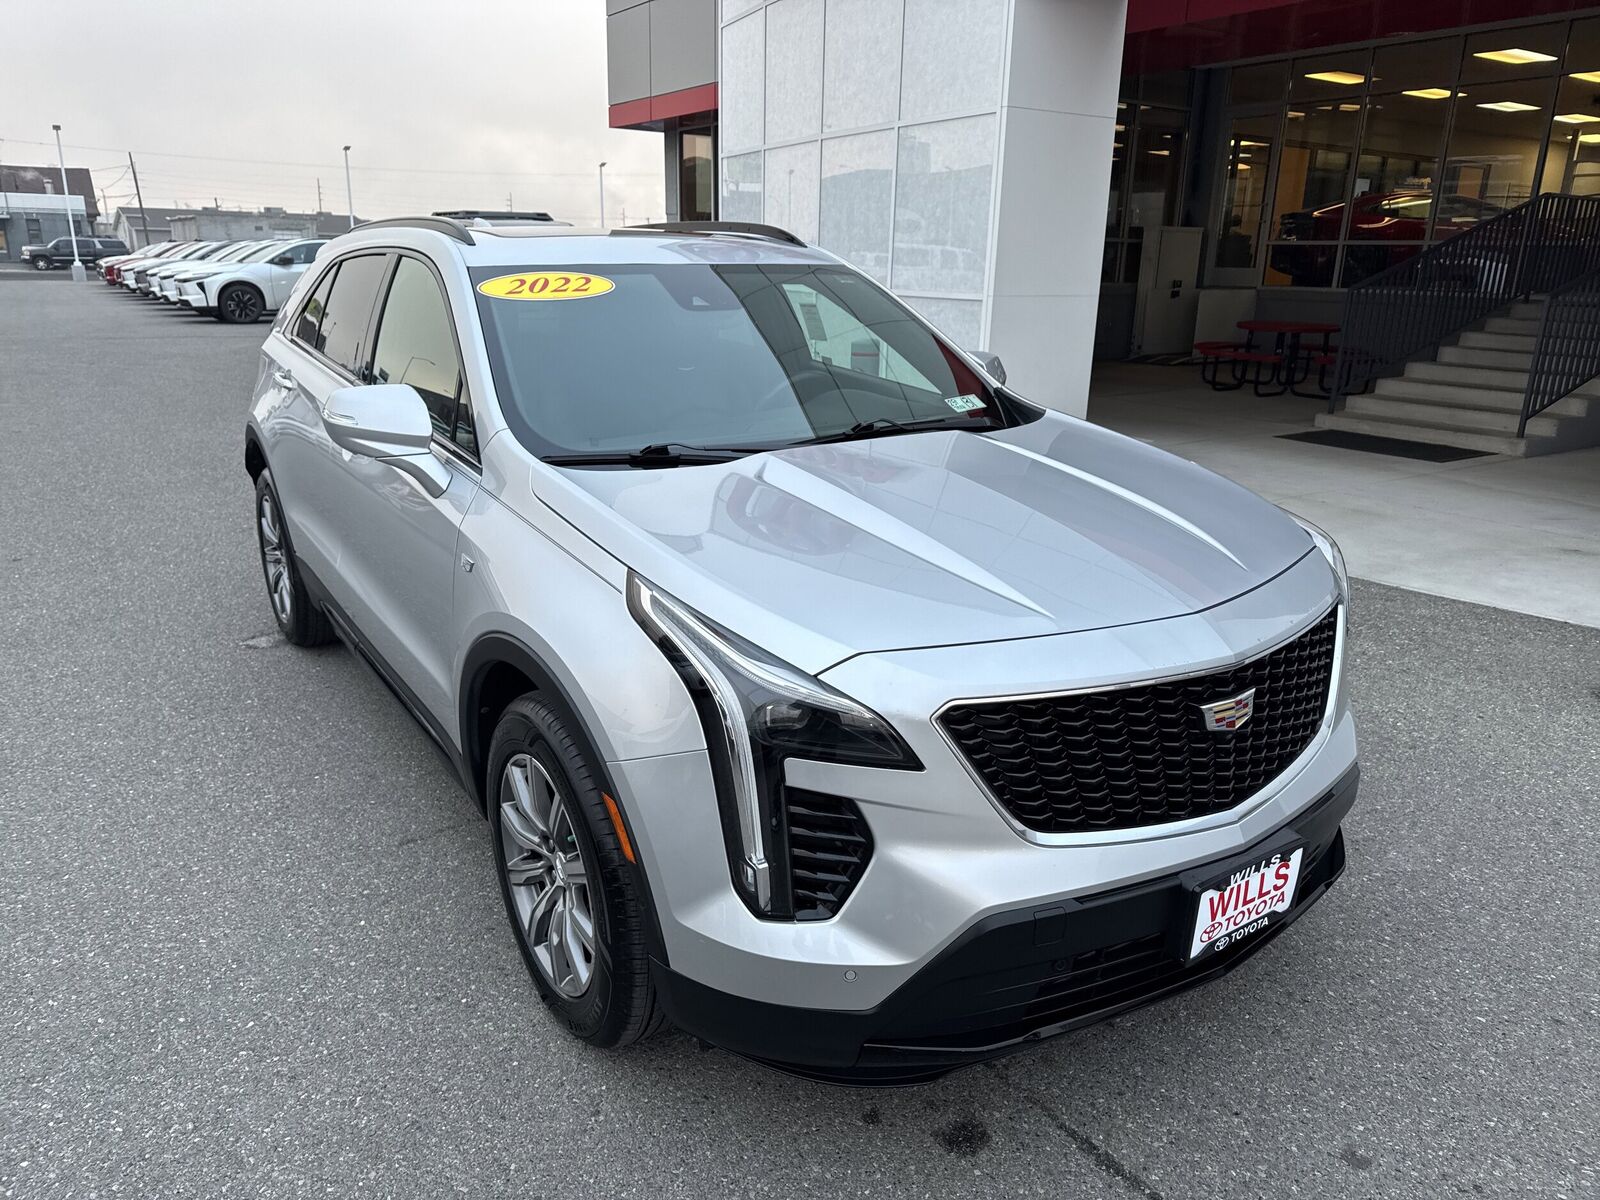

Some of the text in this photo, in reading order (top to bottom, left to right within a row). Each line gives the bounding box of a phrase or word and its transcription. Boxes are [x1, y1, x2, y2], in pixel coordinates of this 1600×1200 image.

[505, 276, 592, 295] 2022
[1231, 854, 1281, 885] WILLS
[1208, 861, 1291, 923] WILLS
[1225, 890, 1286, 931] TOYOTA
[1231, 917, 1269, 942] TOYOTA
